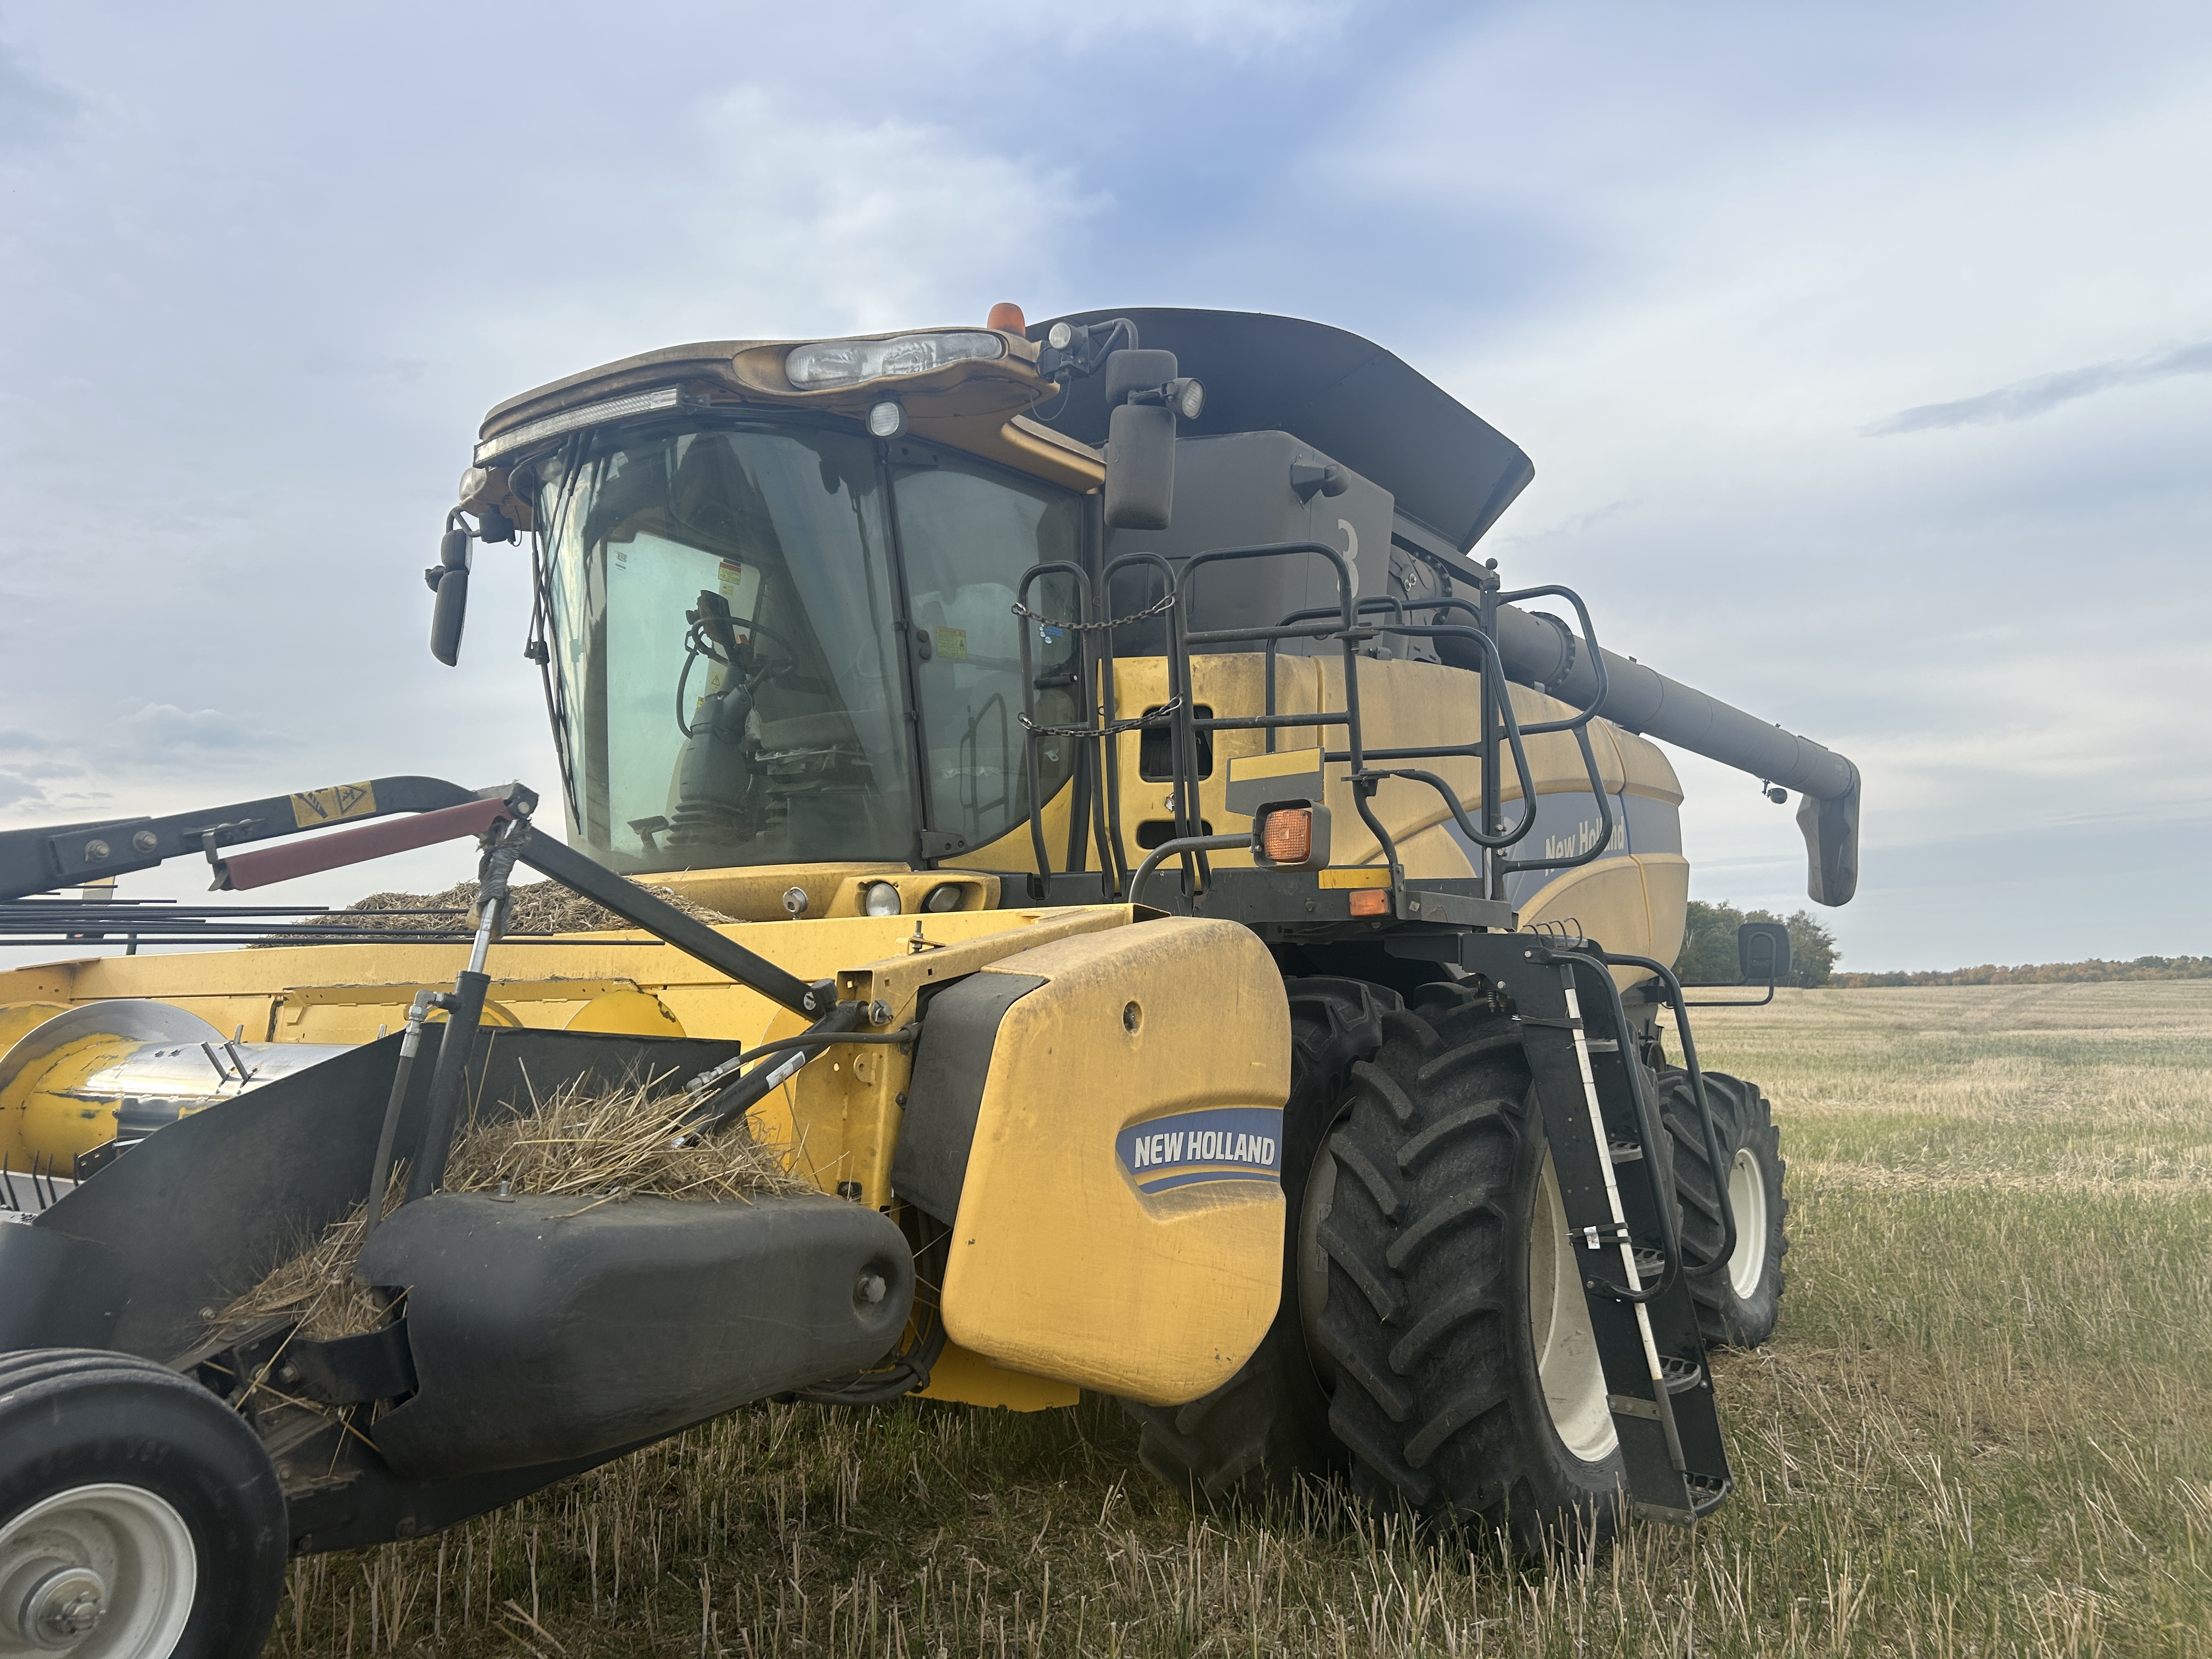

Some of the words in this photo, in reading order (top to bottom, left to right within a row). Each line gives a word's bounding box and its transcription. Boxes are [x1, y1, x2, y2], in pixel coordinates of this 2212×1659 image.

[1544, 834, 1576, 877] New
[1579, 815, 1624, 856] Holnd
[1135, 1132, 1184, 1168] NEW
[1187, 1131, 1275, 1165] HOLLAND
